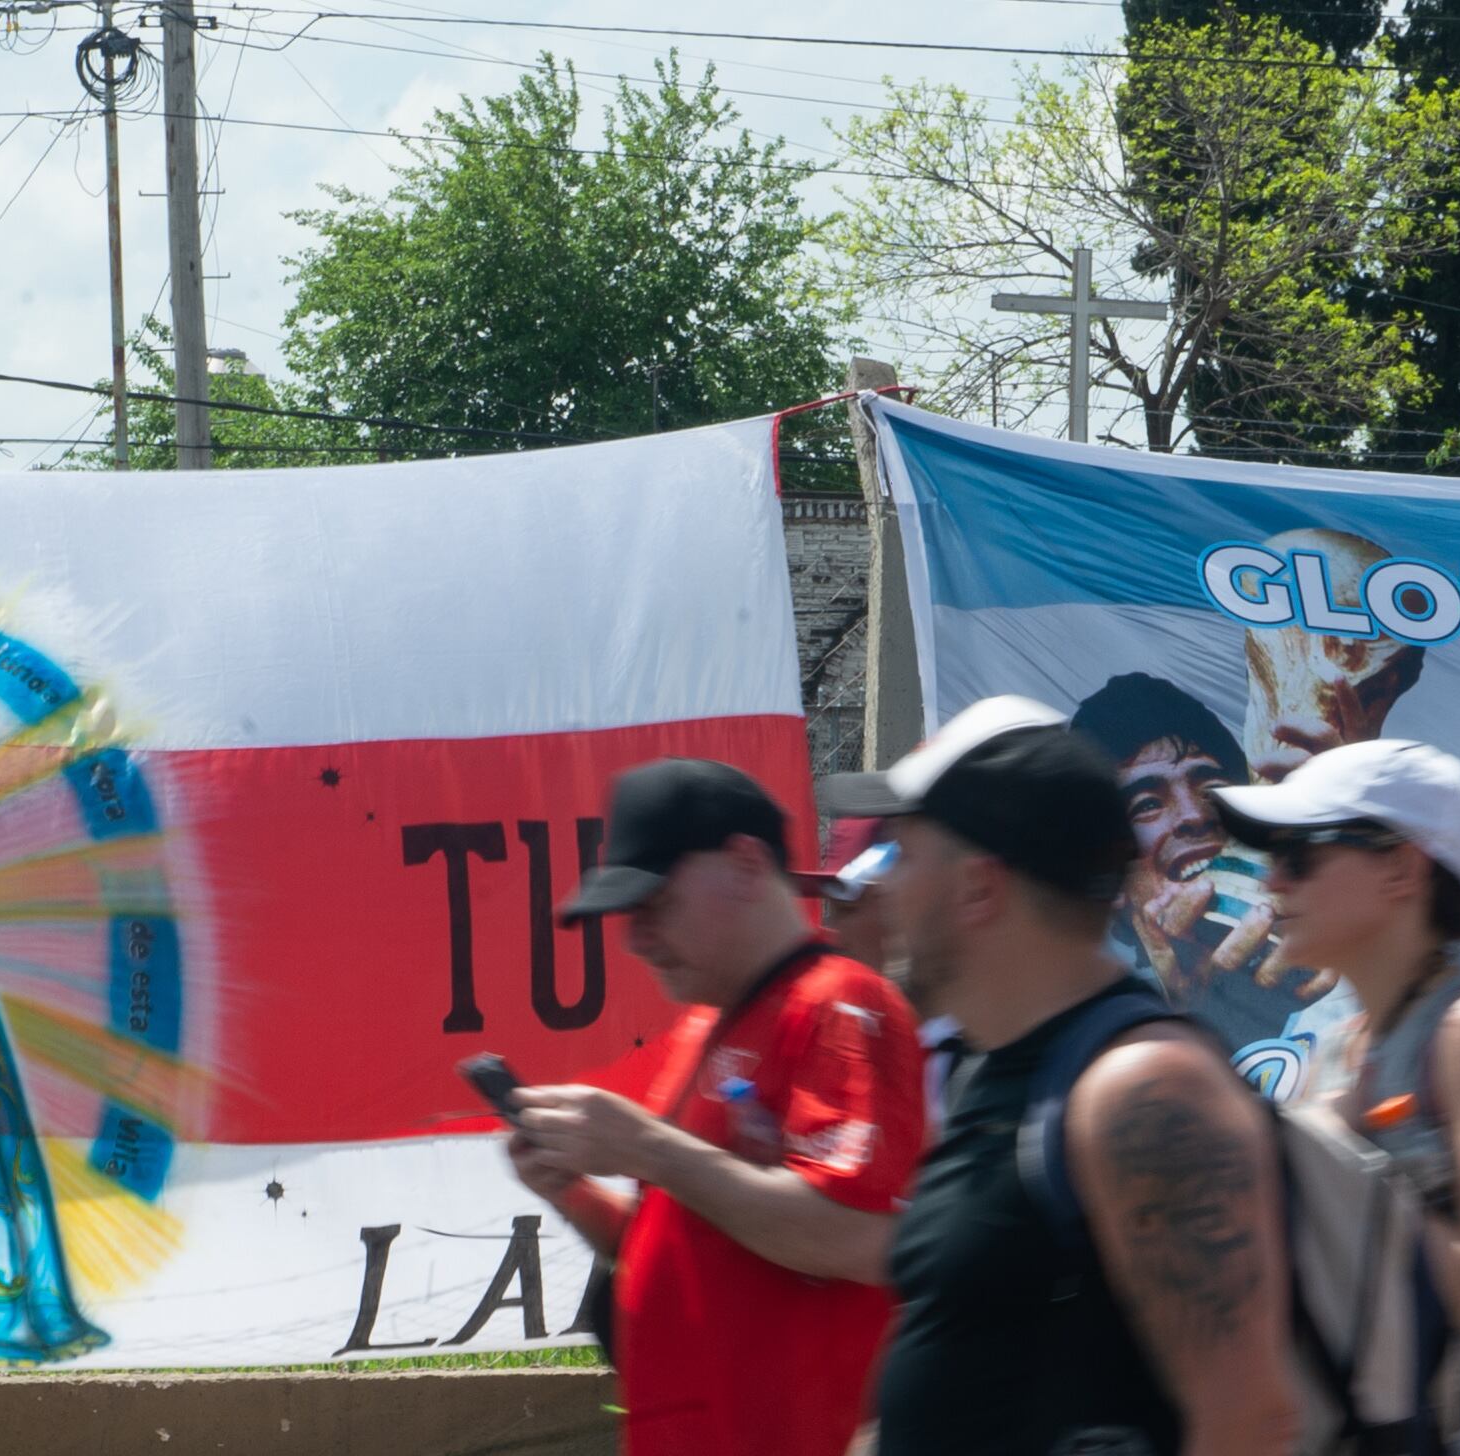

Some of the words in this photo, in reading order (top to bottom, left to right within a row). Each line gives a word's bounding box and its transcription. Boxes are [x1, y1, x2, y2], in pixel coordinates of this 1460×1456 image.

[128, 919, 157, 961] de
[401, 817, 606, 1035] TU
[129, 971, 154, 1033] esta
